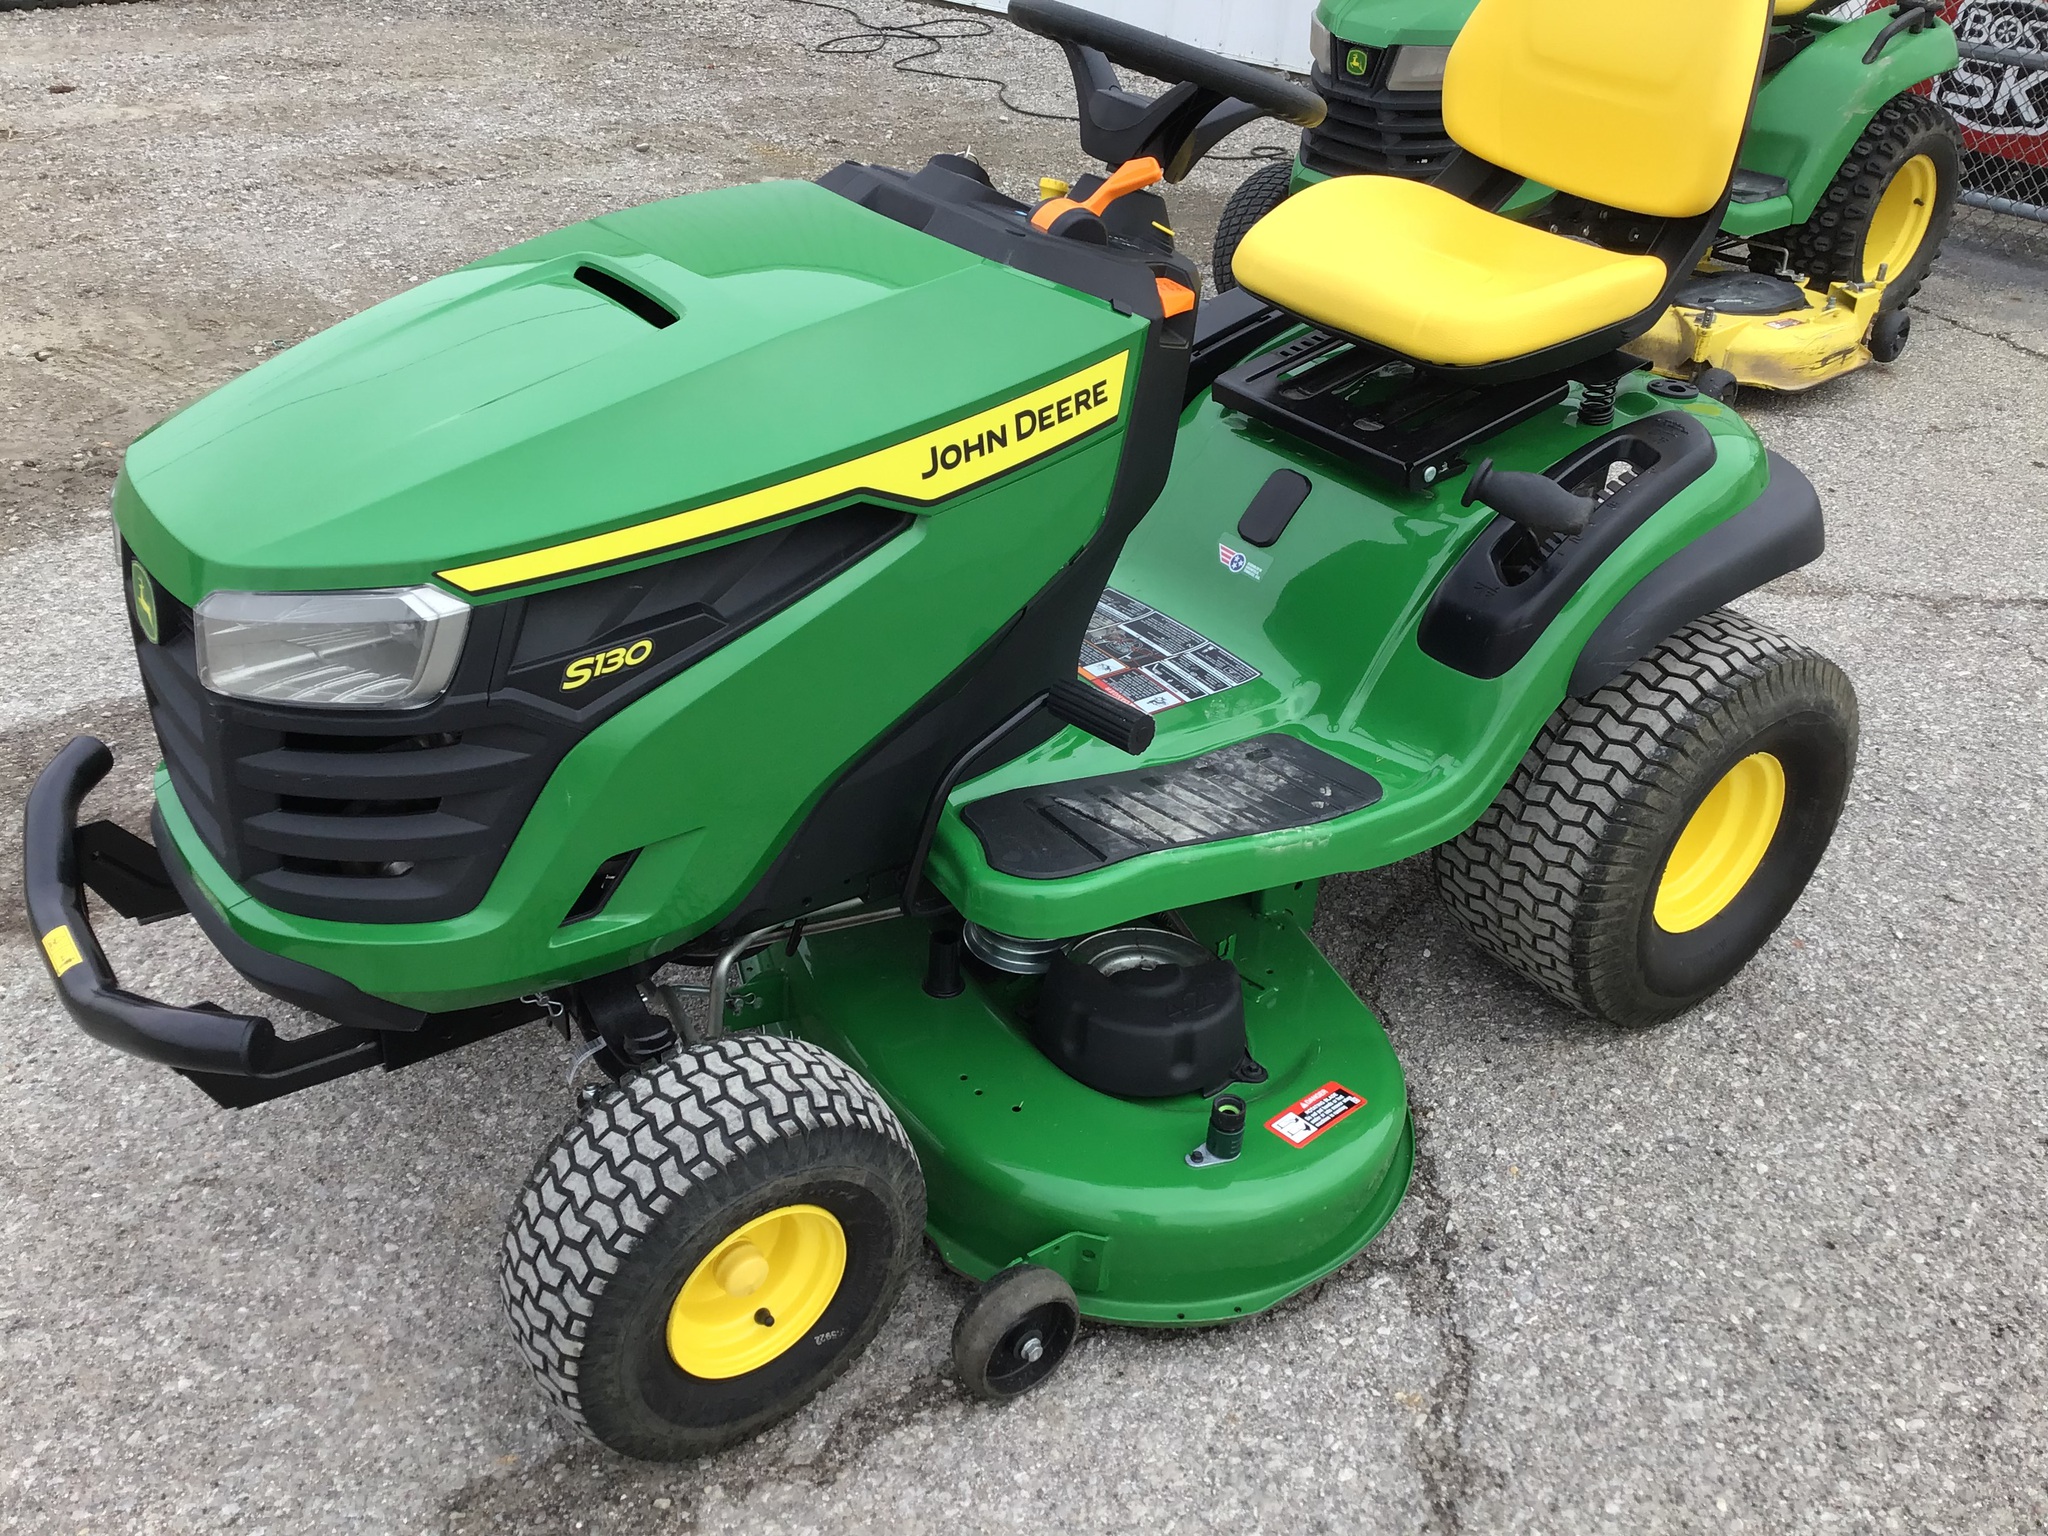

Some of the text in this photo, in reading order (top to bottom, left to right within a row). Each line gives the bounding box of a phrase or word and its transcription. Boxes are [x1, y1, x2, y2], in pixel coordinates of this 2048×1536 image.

[921, 379, 1109, 480] JOHN DEERE
[561, 638, 654, 691] S130
